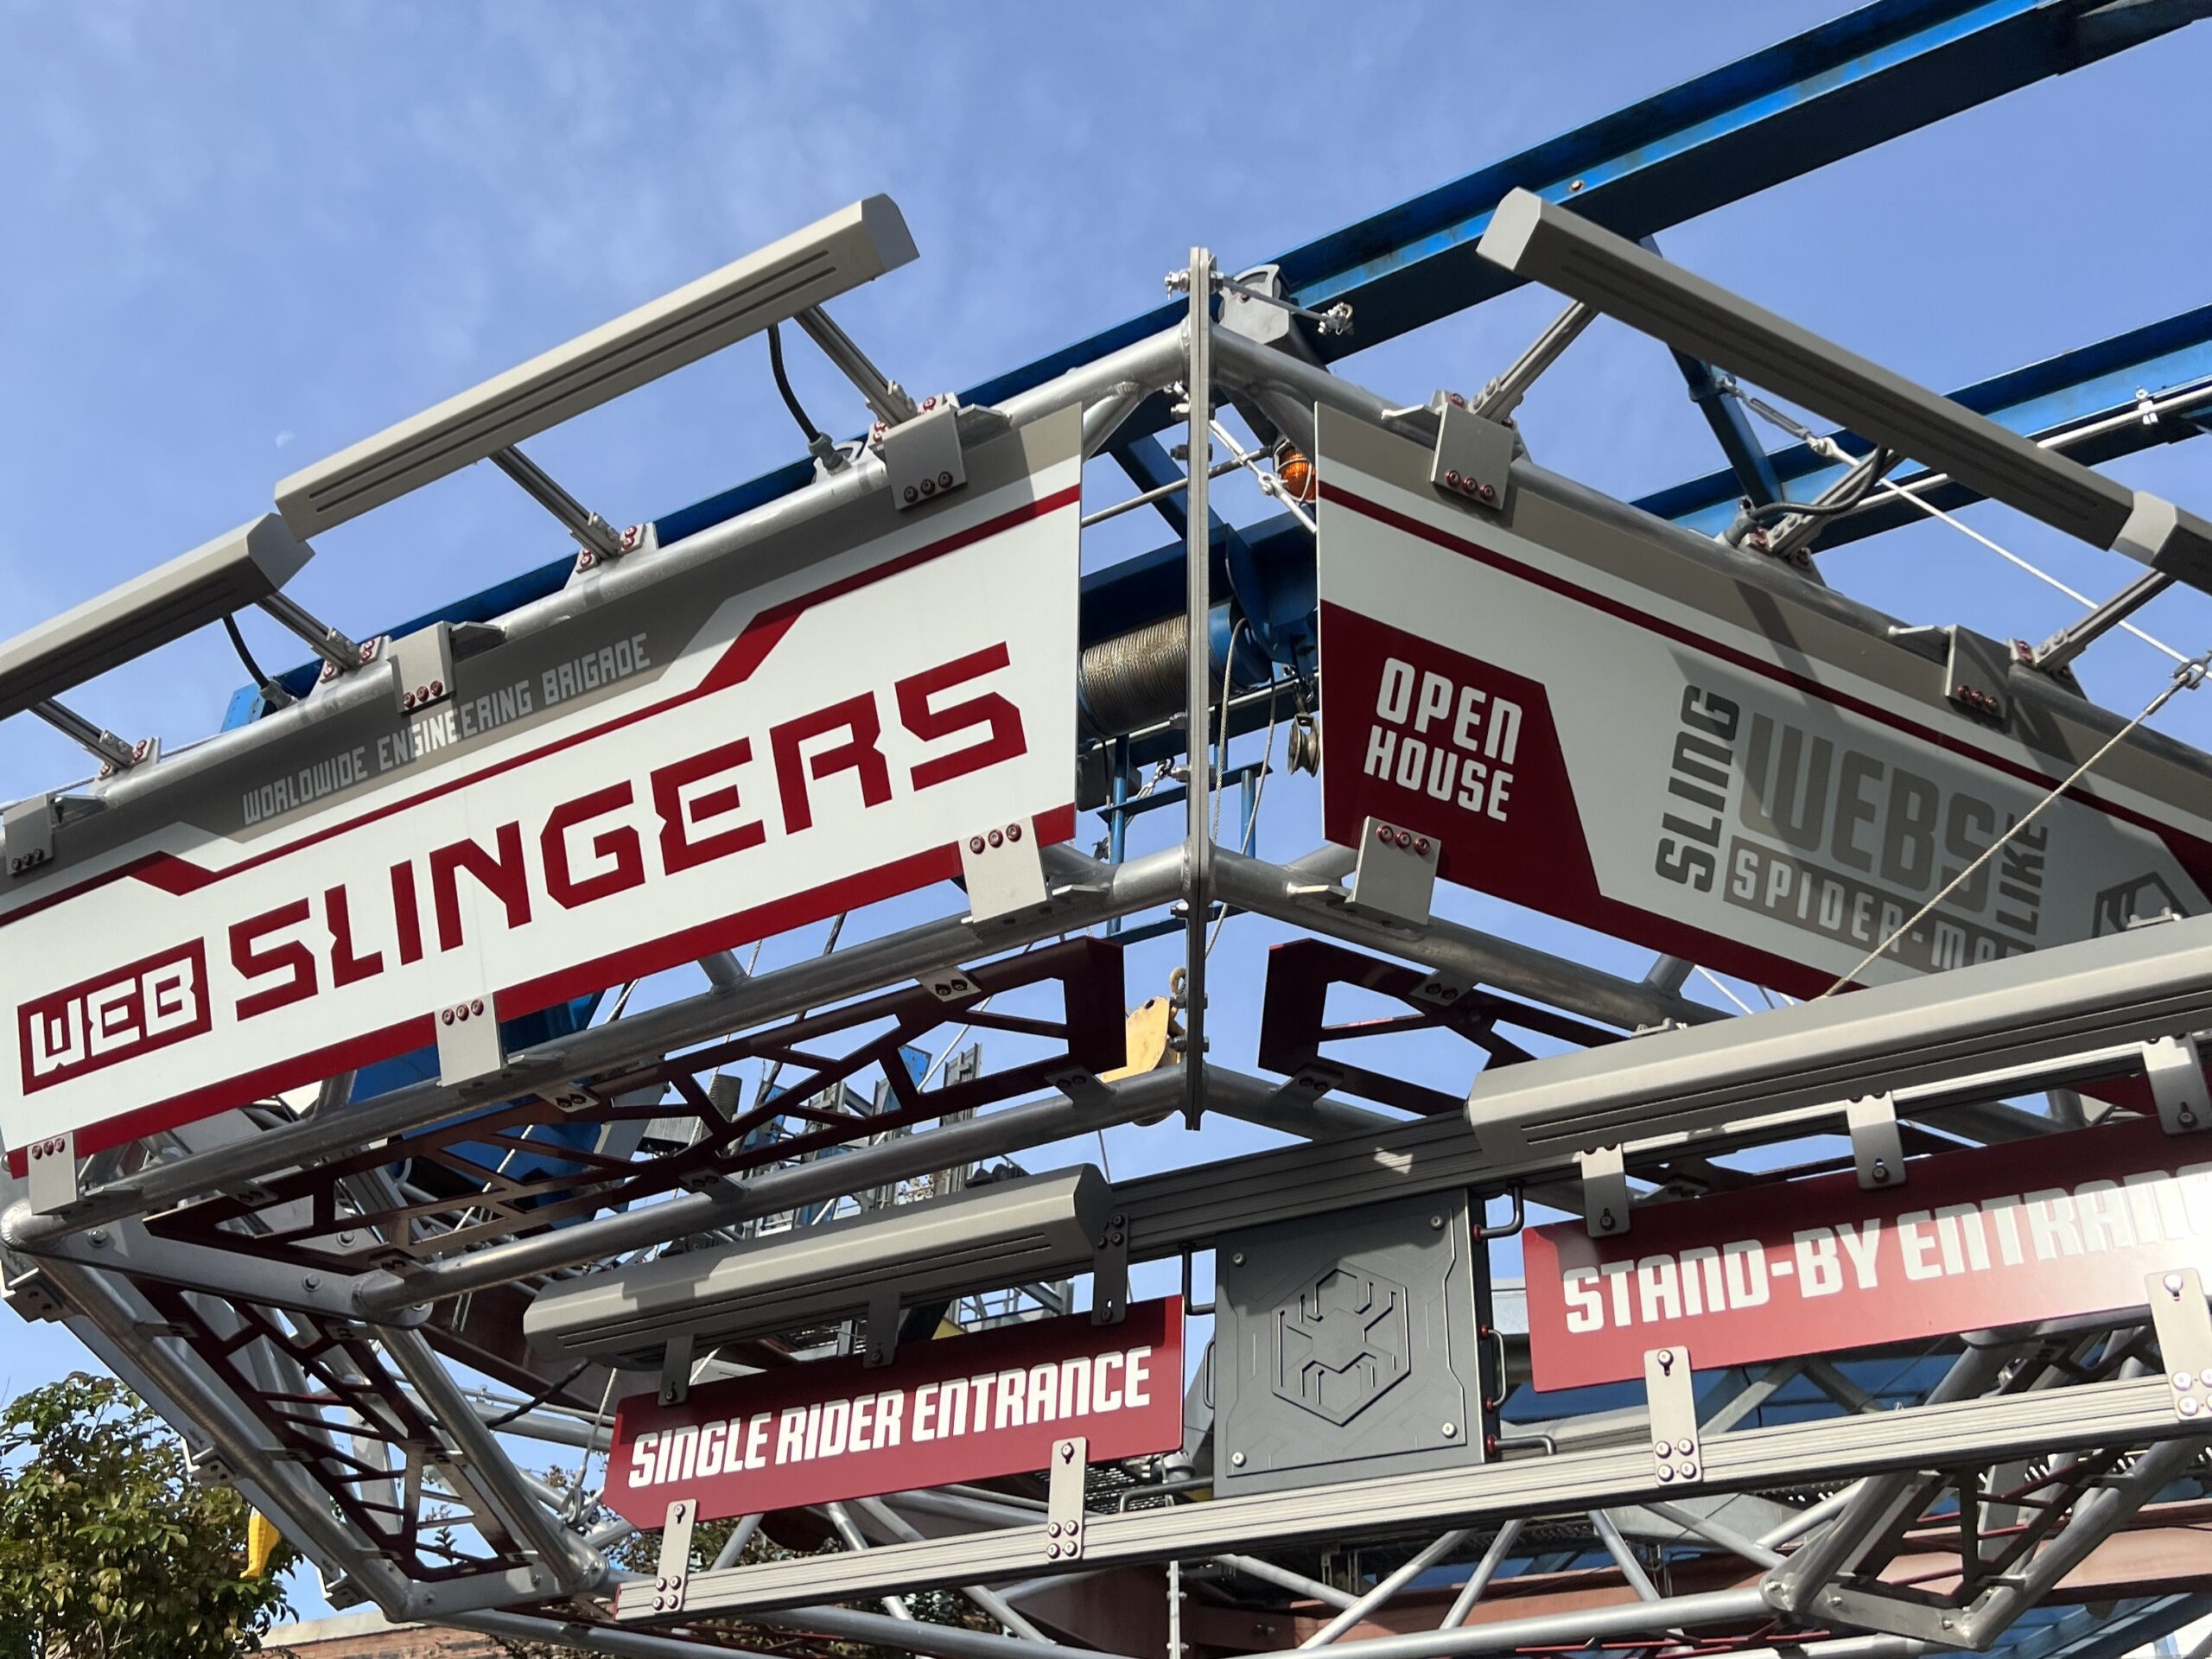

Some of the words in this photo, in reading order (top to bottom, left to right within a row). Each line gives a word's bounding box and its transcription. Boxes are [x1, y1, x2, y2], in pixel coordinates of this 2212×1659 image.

[243, 747, 367, 826] WORLDWIDE
[378, 680, 532, 771] ENGINEERING
[542, 633, 650, 707] BRIGADE
[1363, 725, 1514, 822] HOUSE
[1376, 658, 1522, 765] OPEN
[1655, 684, 1740, 893] SLING
[1738, 713, 1995, 914] WEBS
[29, 956, 200, 1077] WEB
[229, 641, 1027, 1021] SLINGERS
[1732, 848, 2024, 970] SPIDER-MA
[1995, 812, 2049, 936] LIKE
[1563, 1218, 1883, 1333] STAND-BY
[628, 1411, 772, 1489] SINGLE
[775, 1389, 902, 1465] RIDER
[912, 1346, 1153, 1440] ENTRANCE
